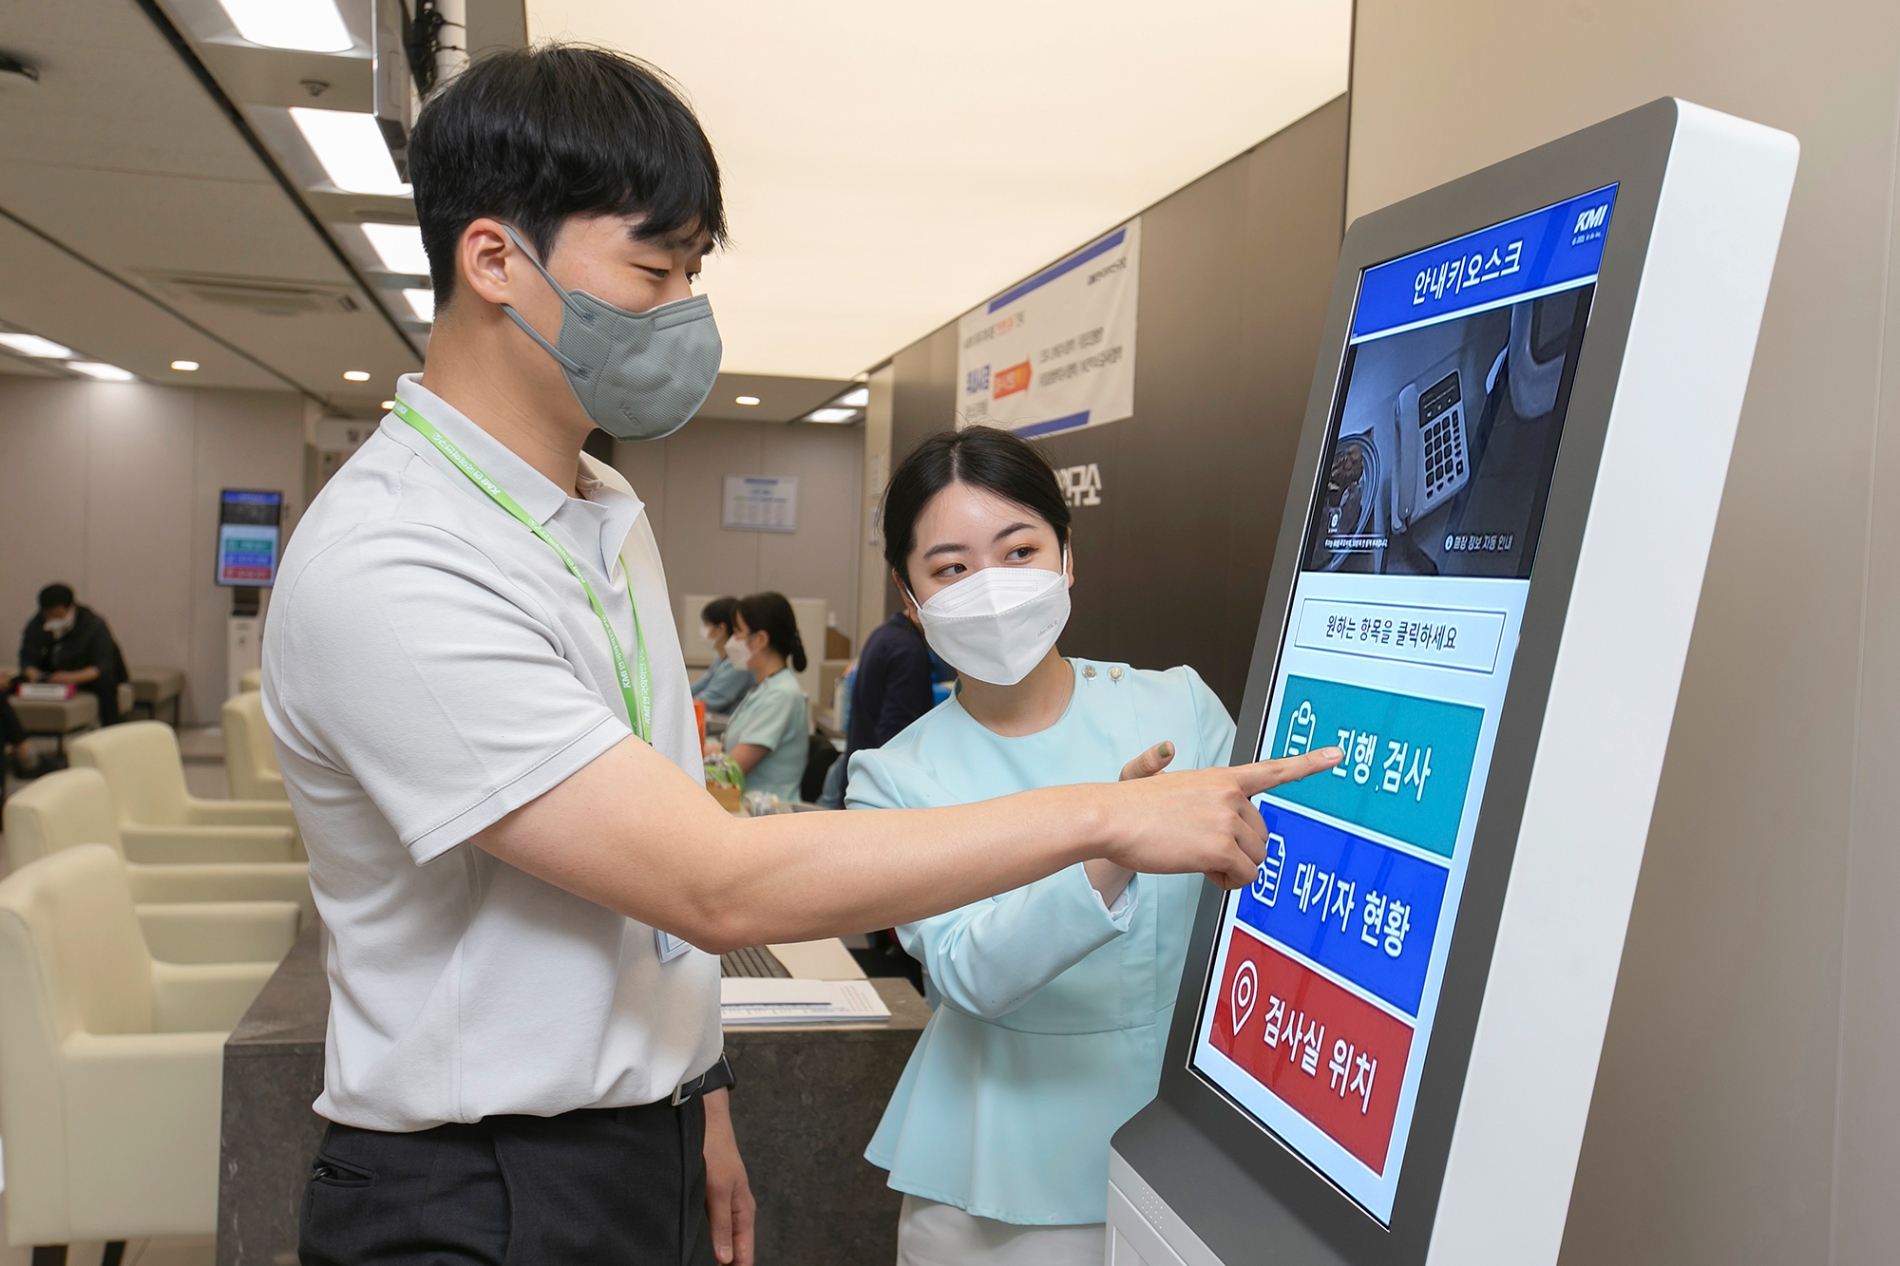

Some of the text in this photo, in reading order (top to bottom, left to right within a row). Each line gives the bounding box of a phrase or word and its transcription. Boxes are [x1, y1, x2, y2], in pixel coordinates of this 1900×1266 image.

[1574, 203, 1609, 234] KMI
[1412, 240, 1521, 304] 안내키오스크
[480, 477, 500, 494] KMI
[1326, 615, 1458, 651] 원하는 항목을 클릭하세요
[620, 670, 630, 688] KMI
[1331, 728, 1432, 802] 진행 검사
[1292, 861, 1411, 959] 대기자 현황
[1263, 995, 1379, 1115] 검사실 위치
